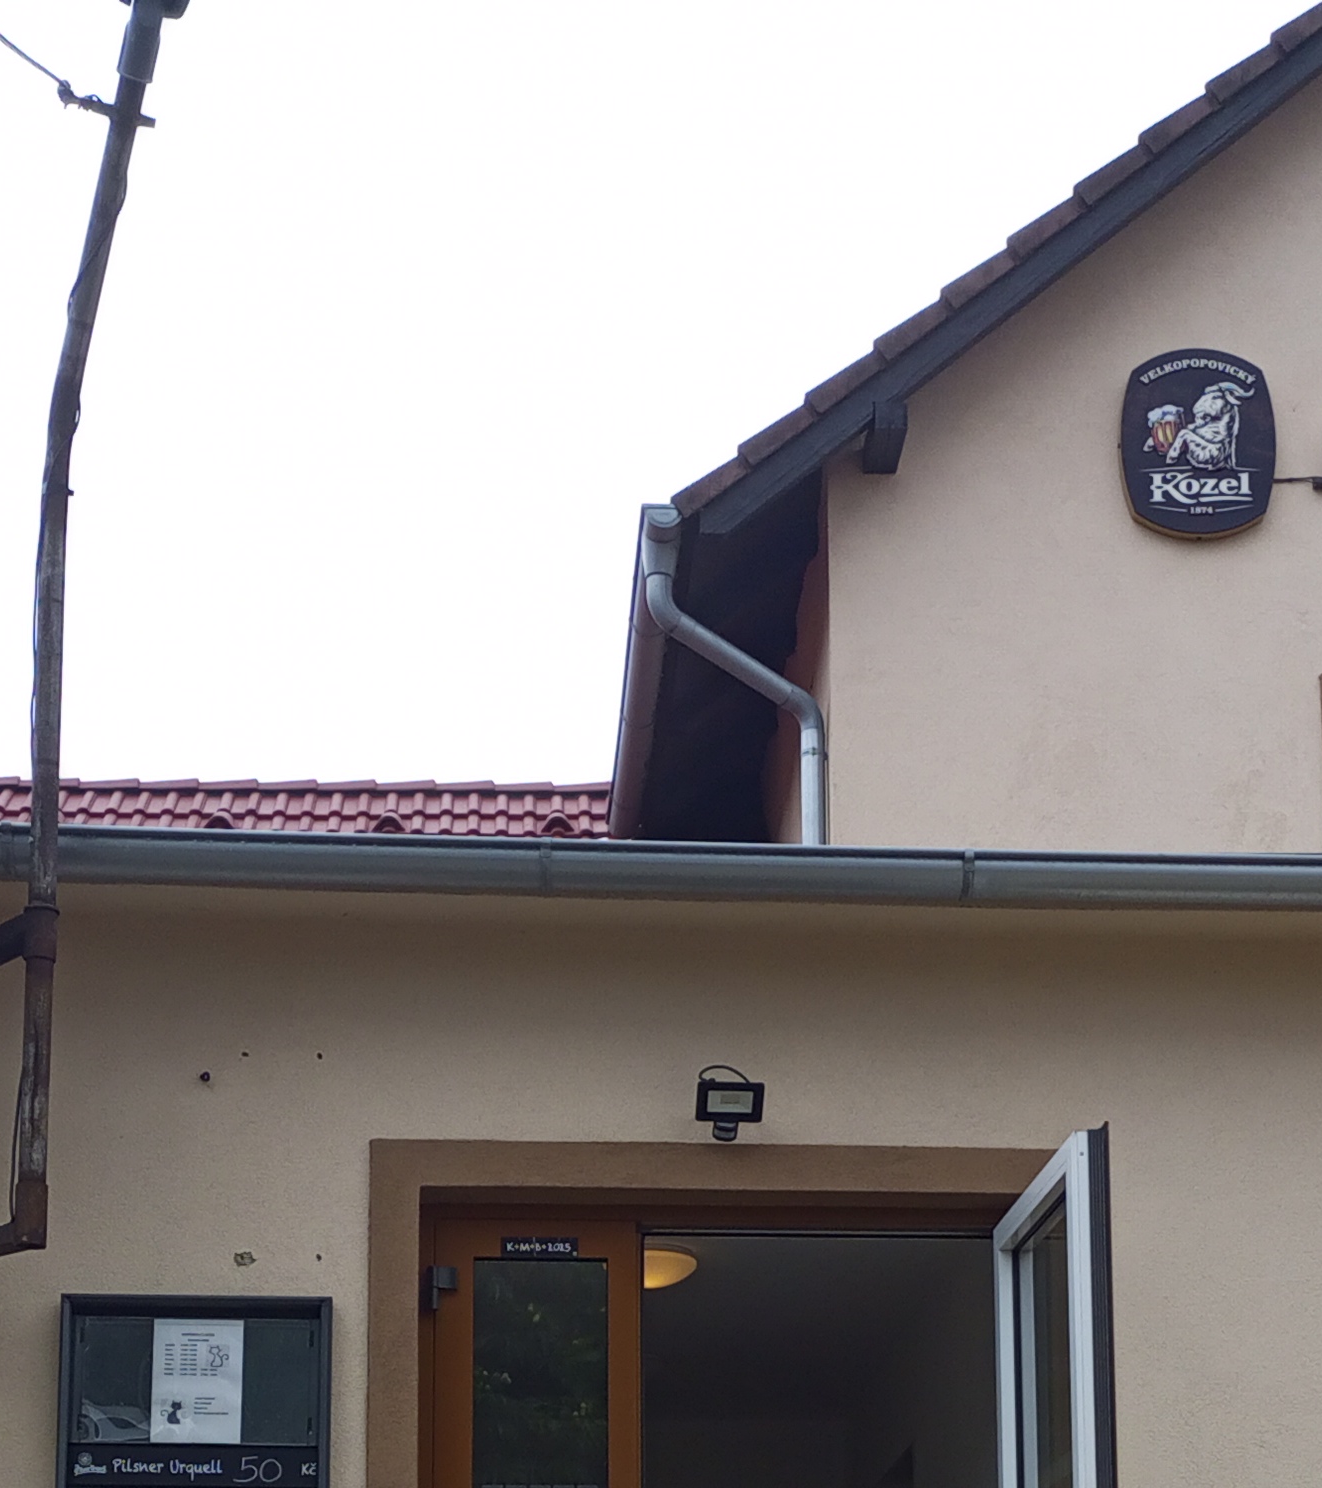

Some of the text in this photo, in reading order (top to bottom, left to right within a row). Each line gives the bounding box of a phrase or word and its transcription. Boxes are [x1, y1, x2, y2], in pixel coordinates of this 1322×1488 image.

[1139, 358, 1257, 385] VELKOPOPOVICKÝ
[1149, 471, 1254, 504] Kozel
[1189, 505, 1214, 515] 1874
[111, 1458, 165, 1474] Pilsner
[169, 1458, 223, 1482] Urquell
[232, 1455, 283, 1483] 50
[300, 1461, 317, 1476] Kč
